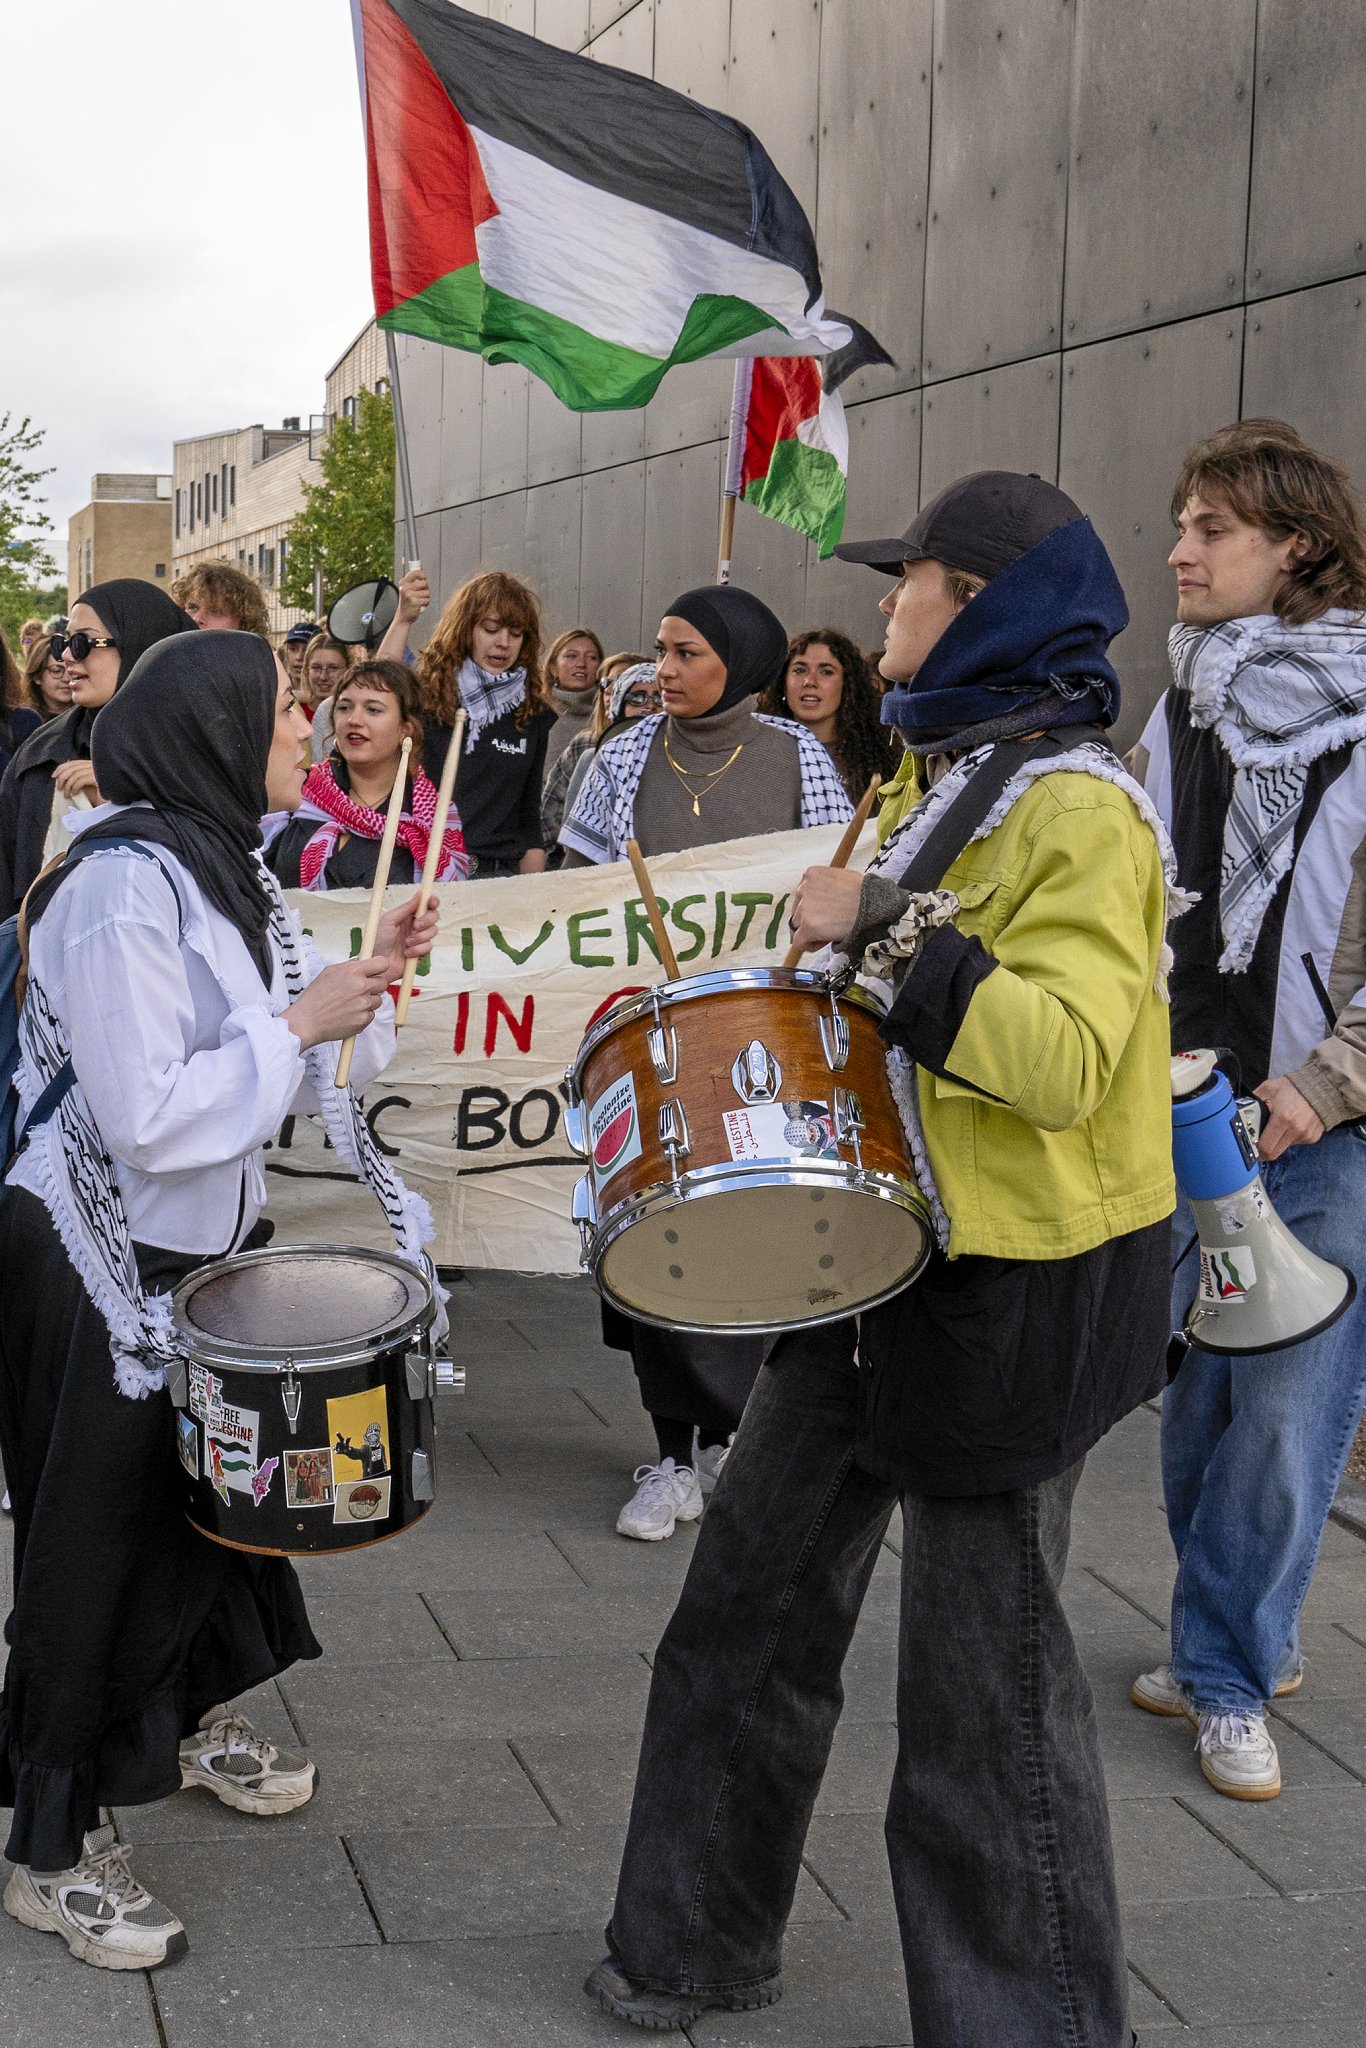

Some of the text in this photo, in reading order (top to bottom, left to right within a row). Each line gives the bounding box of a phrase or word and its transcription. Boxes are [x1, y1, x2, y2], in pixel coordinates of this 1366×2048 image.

[303, 890, 793, 976] IVERSITI
[454, 991, 534, 1058] IN
[457, 1082, 575, 1149] BO
[596, 1094, 632, 1140] Palestine
[727, 1112, 746, 1155] PALESTINE
